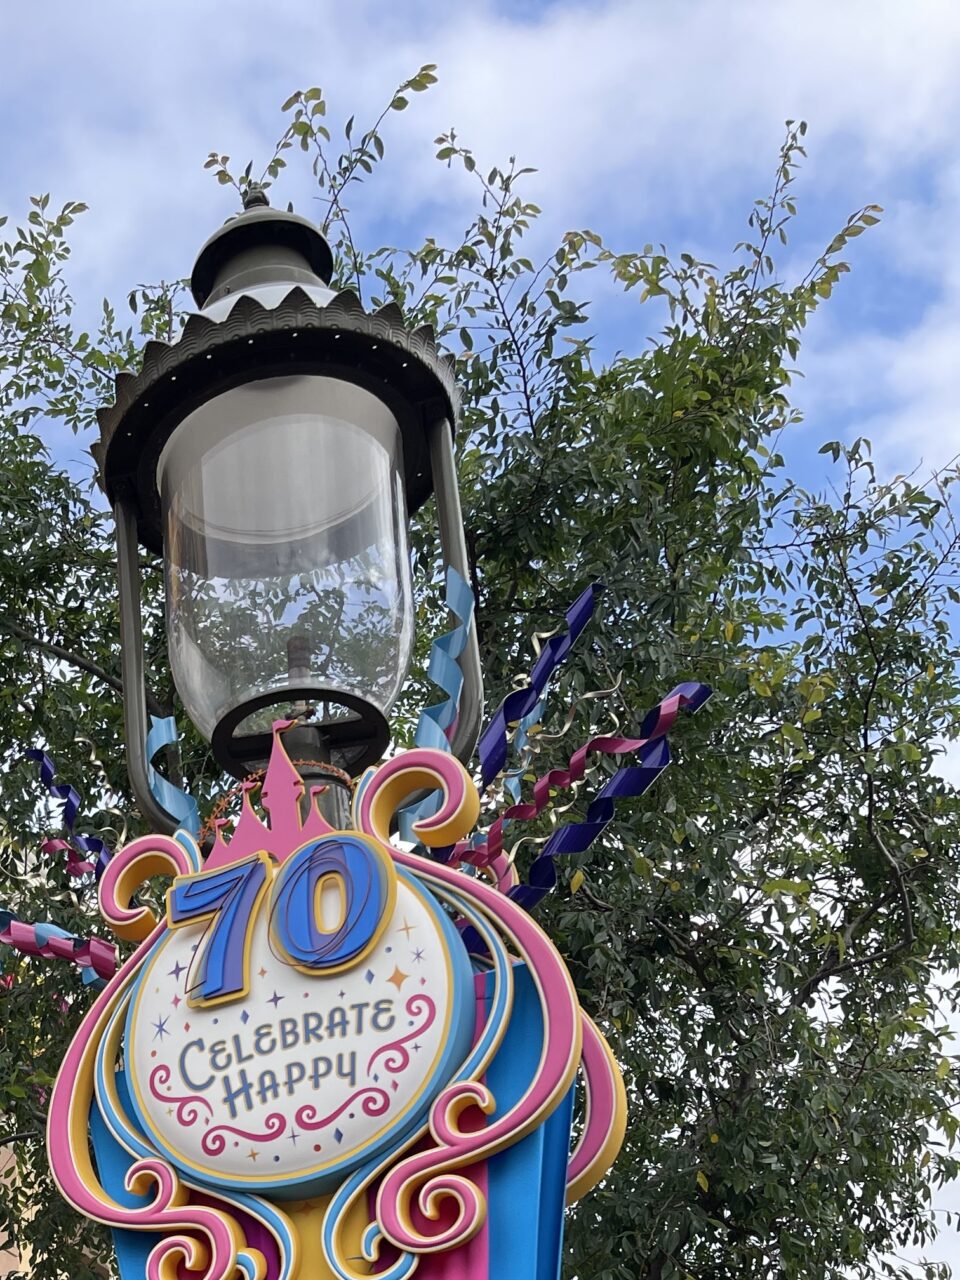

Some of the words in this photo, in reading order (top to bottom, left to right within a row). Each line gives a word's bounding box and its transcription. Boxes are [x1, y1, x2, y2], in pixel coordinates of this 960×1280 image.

[166, 831, 397, 1008] 70
[178, 998, 396, 1092] CELEBRATE
[222, 1050, 358, 1119] HAPPY
